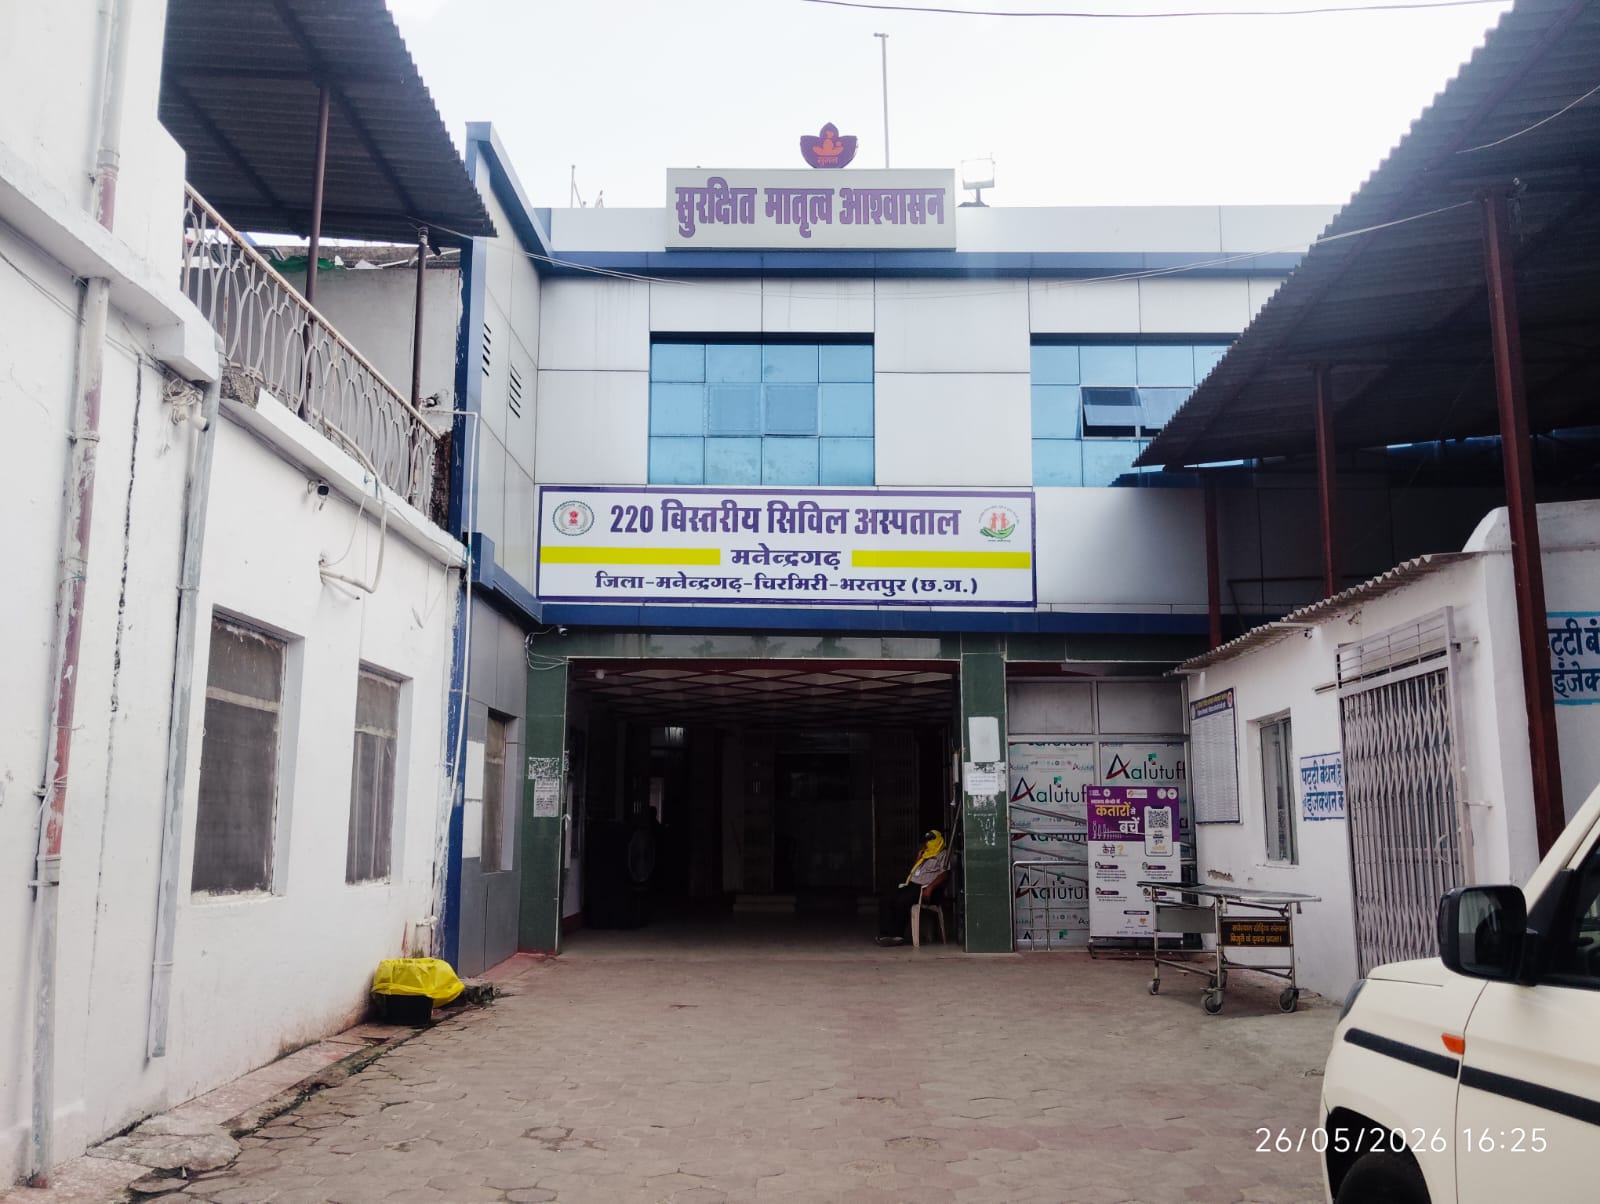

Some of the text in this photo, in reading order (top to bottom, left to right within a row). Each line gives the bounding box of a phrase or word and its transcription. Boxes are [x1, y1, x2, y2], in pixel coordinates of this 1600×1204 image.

[675, 177, 946, 238] सुरक्षित मातृत्व आश्वासन
[610, 505, 654, 533] 220
[661, 499, 762, 533] बिस्तरीय
[767, 500, 850, 534] सिविल
[854, 508, 962, 535] अस्पताल
[730, 543, 842, 570] मनेन्द्रगढ़
[911, 577, 978, 594] (छ.ग.)
[1547, 618, 1600, 660] ट्टी बं
[1551, 661, 1600, 698] इंजेक
[1010, 776, 1093, 803] Aalutuf
[1095, 802, 1131, 816] कतारों
[1118, 817, 1140, 834] बचें
